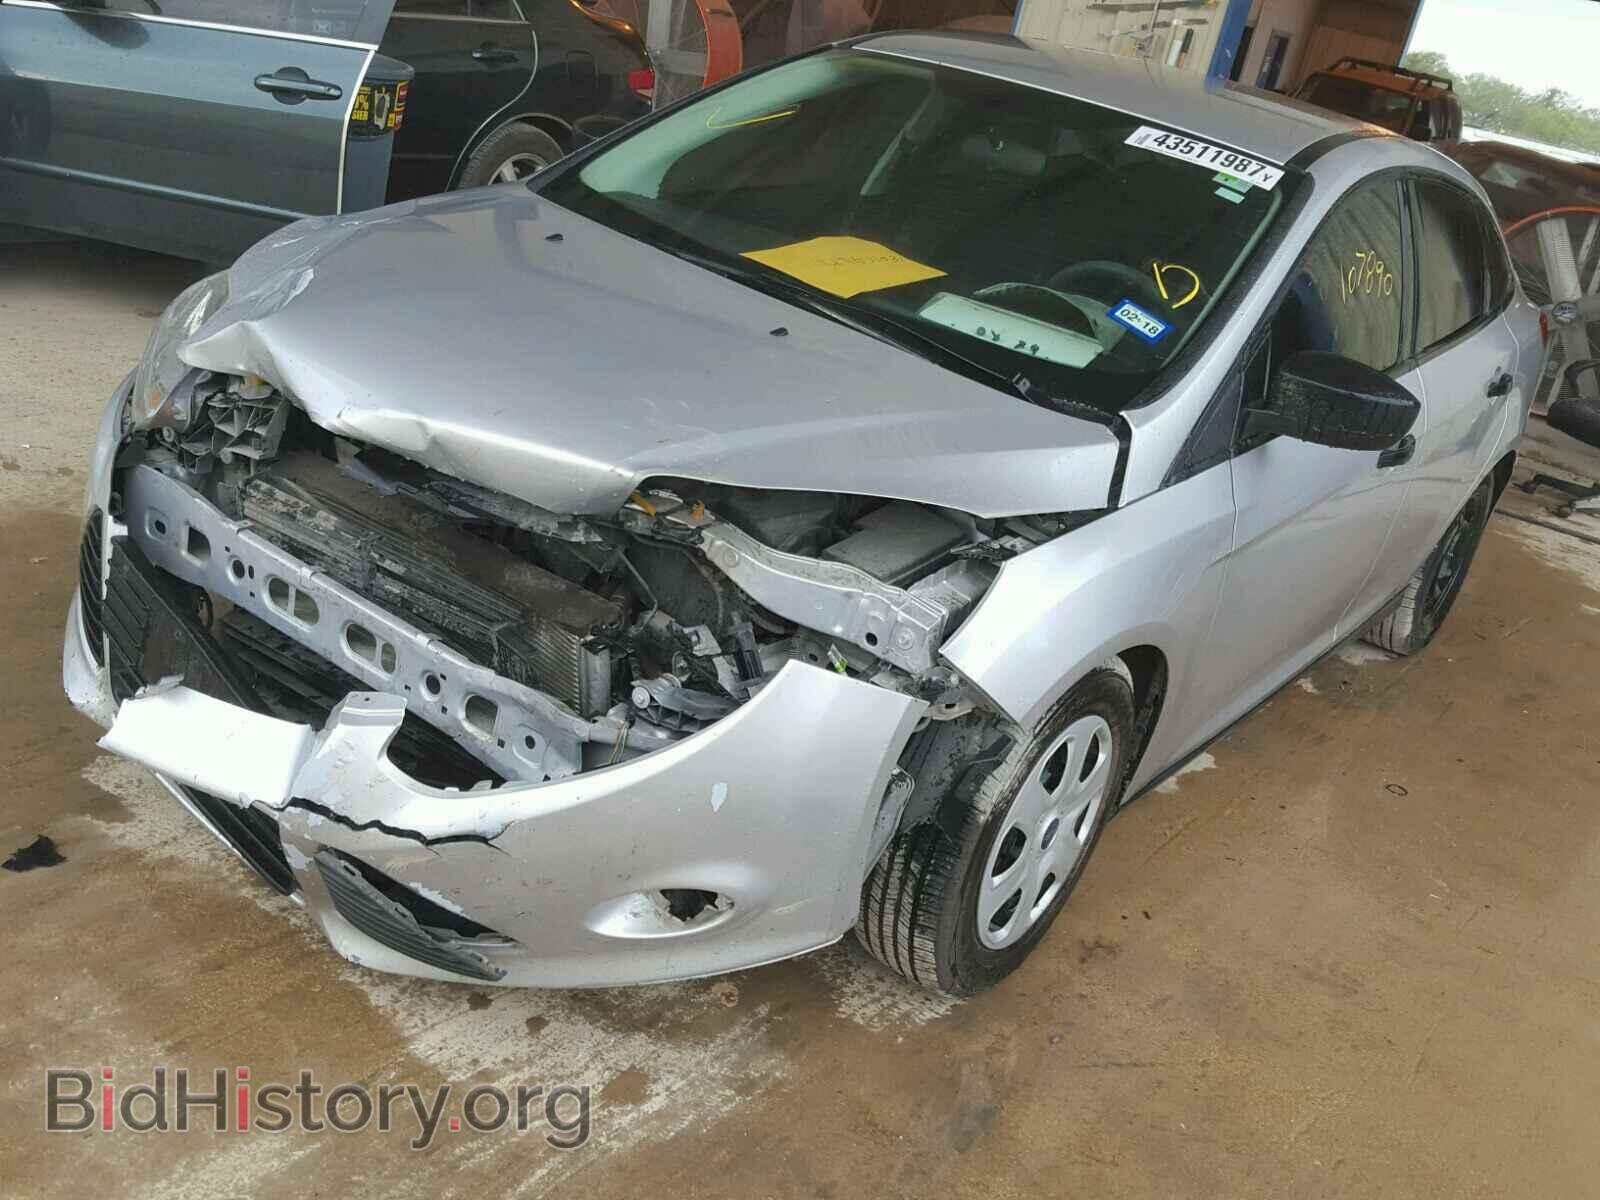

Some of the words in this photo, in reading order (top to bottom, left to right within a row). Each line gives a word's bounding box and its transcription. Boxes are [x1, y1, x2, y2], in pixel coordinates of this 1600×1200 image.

[1153, 133, 1267, 177] 43511987
[1263, 173, 1273, 182] Y
[1340, 250, 1393, 305] 107890
